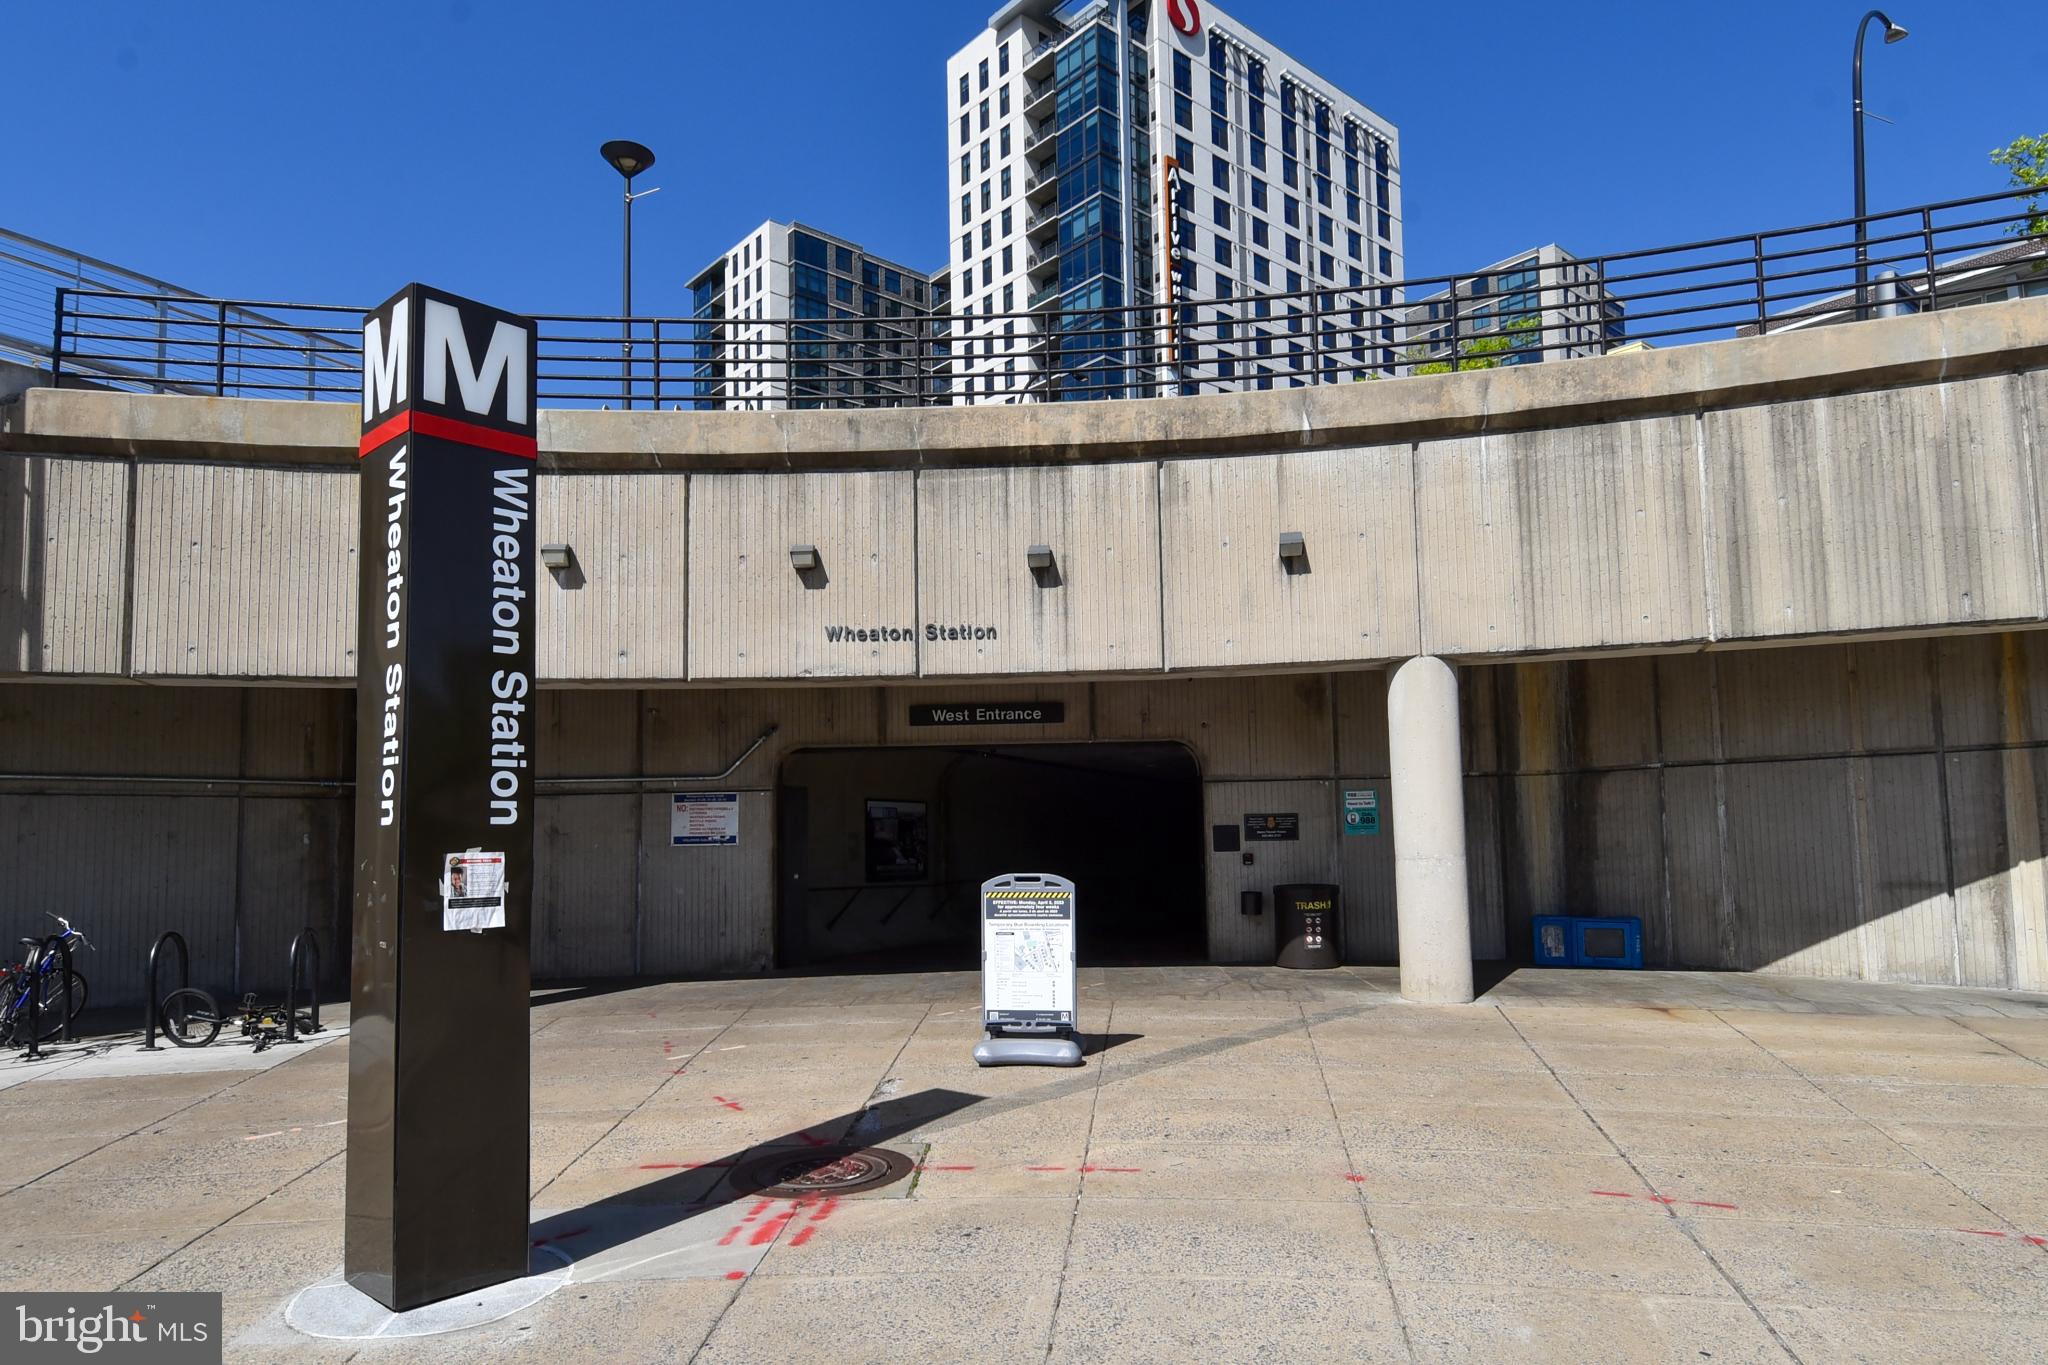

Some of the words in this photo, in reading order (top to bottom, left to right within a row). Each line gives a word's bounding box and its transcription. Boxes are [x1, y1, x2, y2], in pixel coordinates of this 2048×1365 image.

[1168, 167, 1181, 260] Arrive
[364, 296, 409, 425] M
[423, 297, 528, 426] M
[387, 444, 407, 649] Wheaton
[492, 468, 529, 655] Wheaton
[824, 626, 913, 643] Wheaton
[925, 623, 997, 641] Station
[380, 663, 403, 826] Station
[489, 670, 529, 825] Station
[932, 709, 969, 722] West
[976, 708, 1042, 721] Entrance
[1360, 816, 1376, 824] 988
